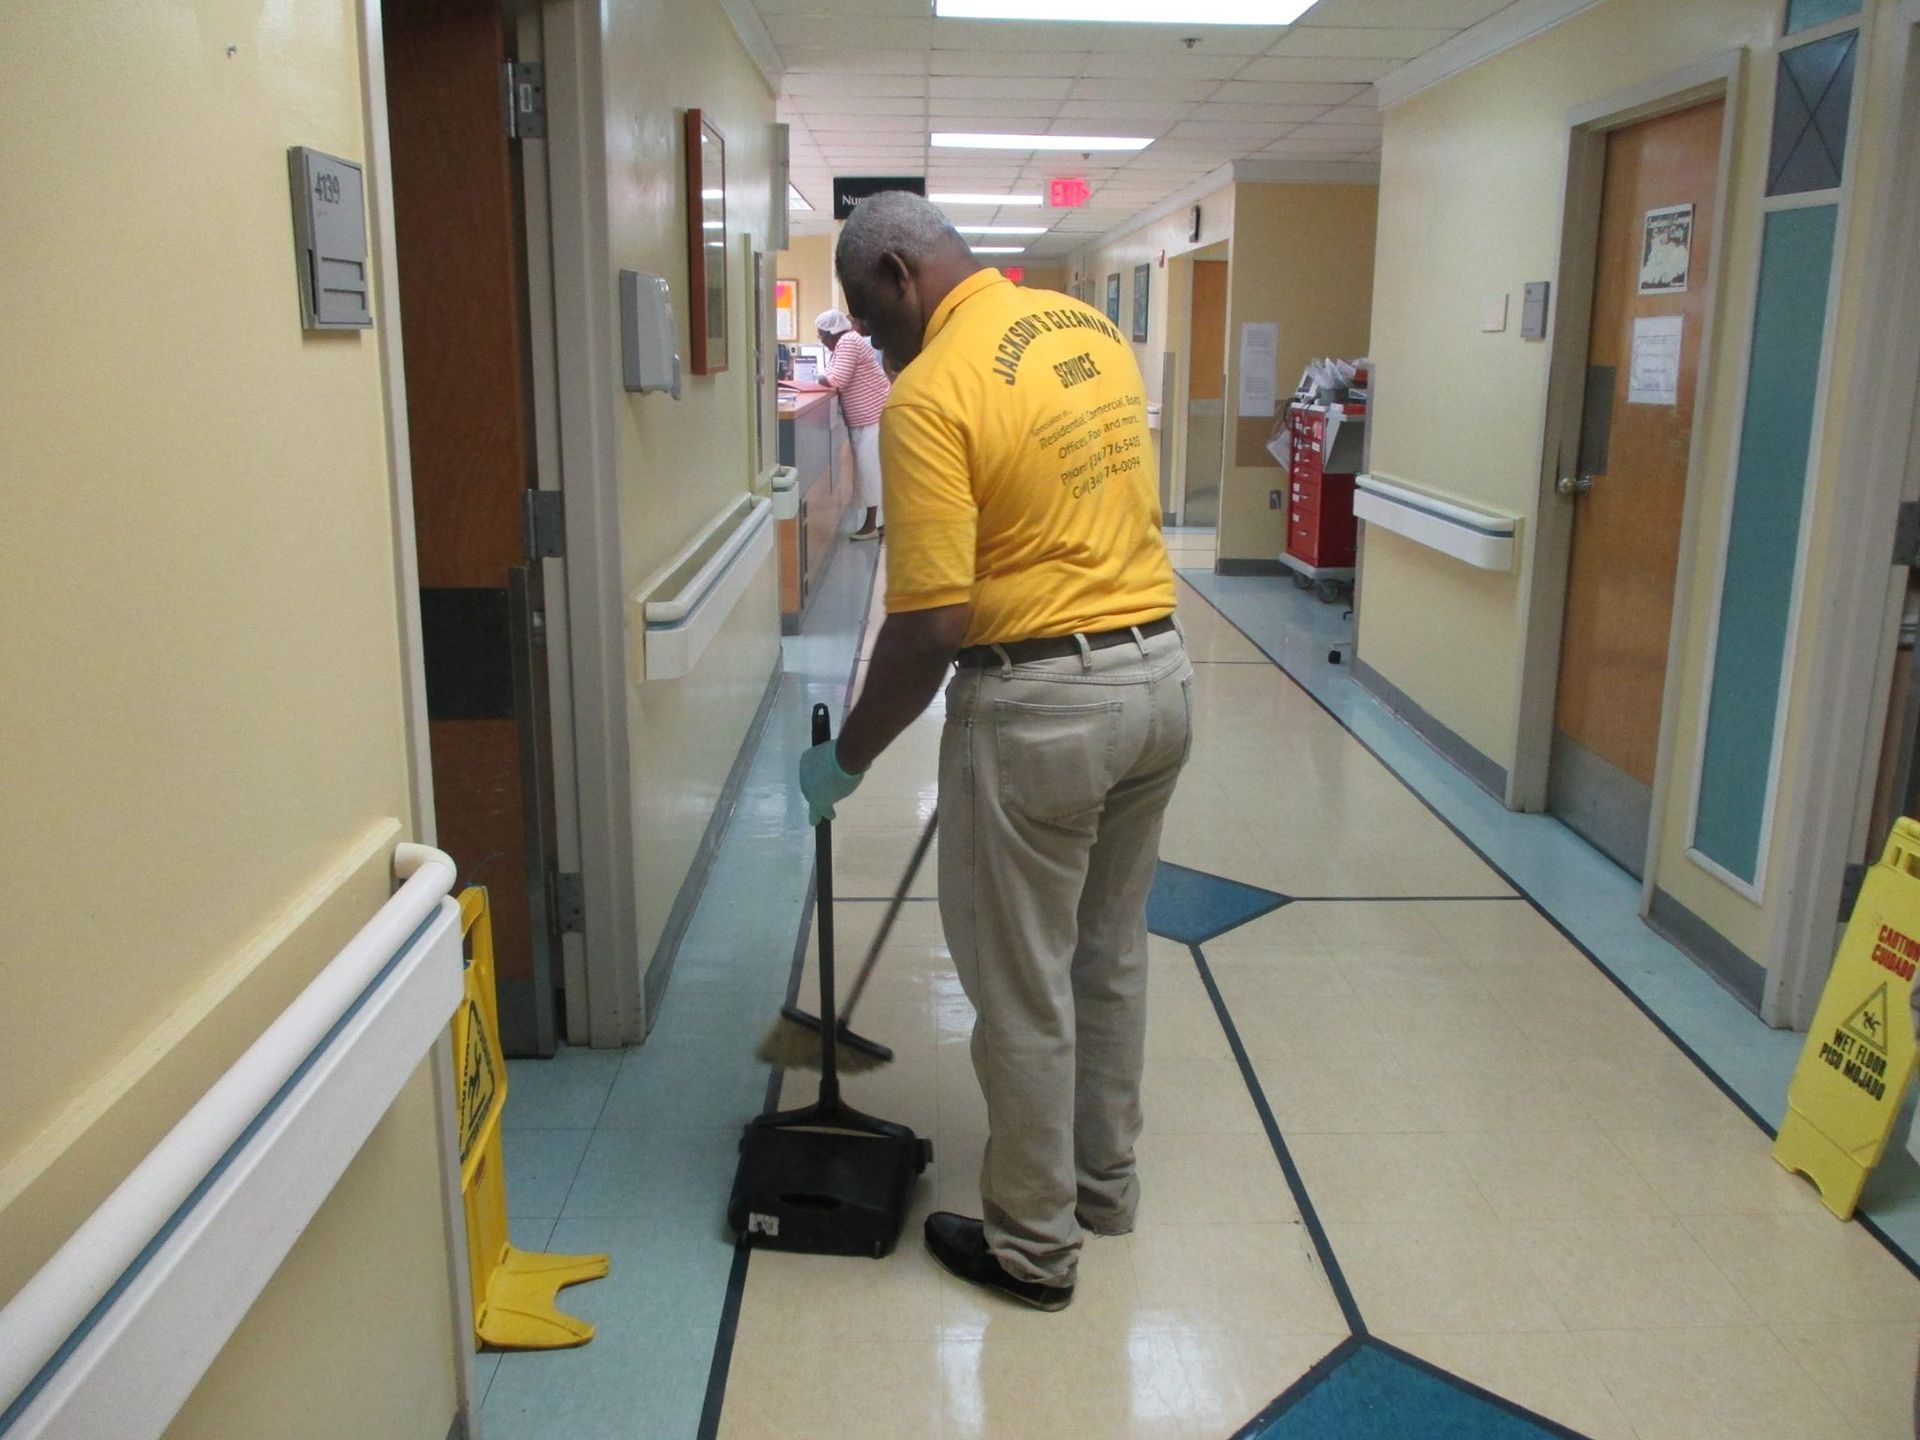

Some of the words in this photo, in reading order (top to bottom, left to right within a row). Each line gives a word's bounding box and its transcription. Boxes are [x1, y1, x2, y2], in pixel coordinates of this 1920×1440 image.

[314, 172, 341, 205] 4139
[993, 313, 1052, 386] JACKSON'S
[1052, 352, 1102, 389] SERVICE
[1102, 417, 1121, 433] and
[1870, 943, 1917, 983] CUIDADO
[1878, 923, 1920, 963] CAUTION
[1819, 1042, 1845, 1071] PISO
[1842, 1058, 1887, 1102] MOJADO
[1832, 1027, 1858, 1056] WET
[1855, 1044, 1888, 1079] FLOOR
